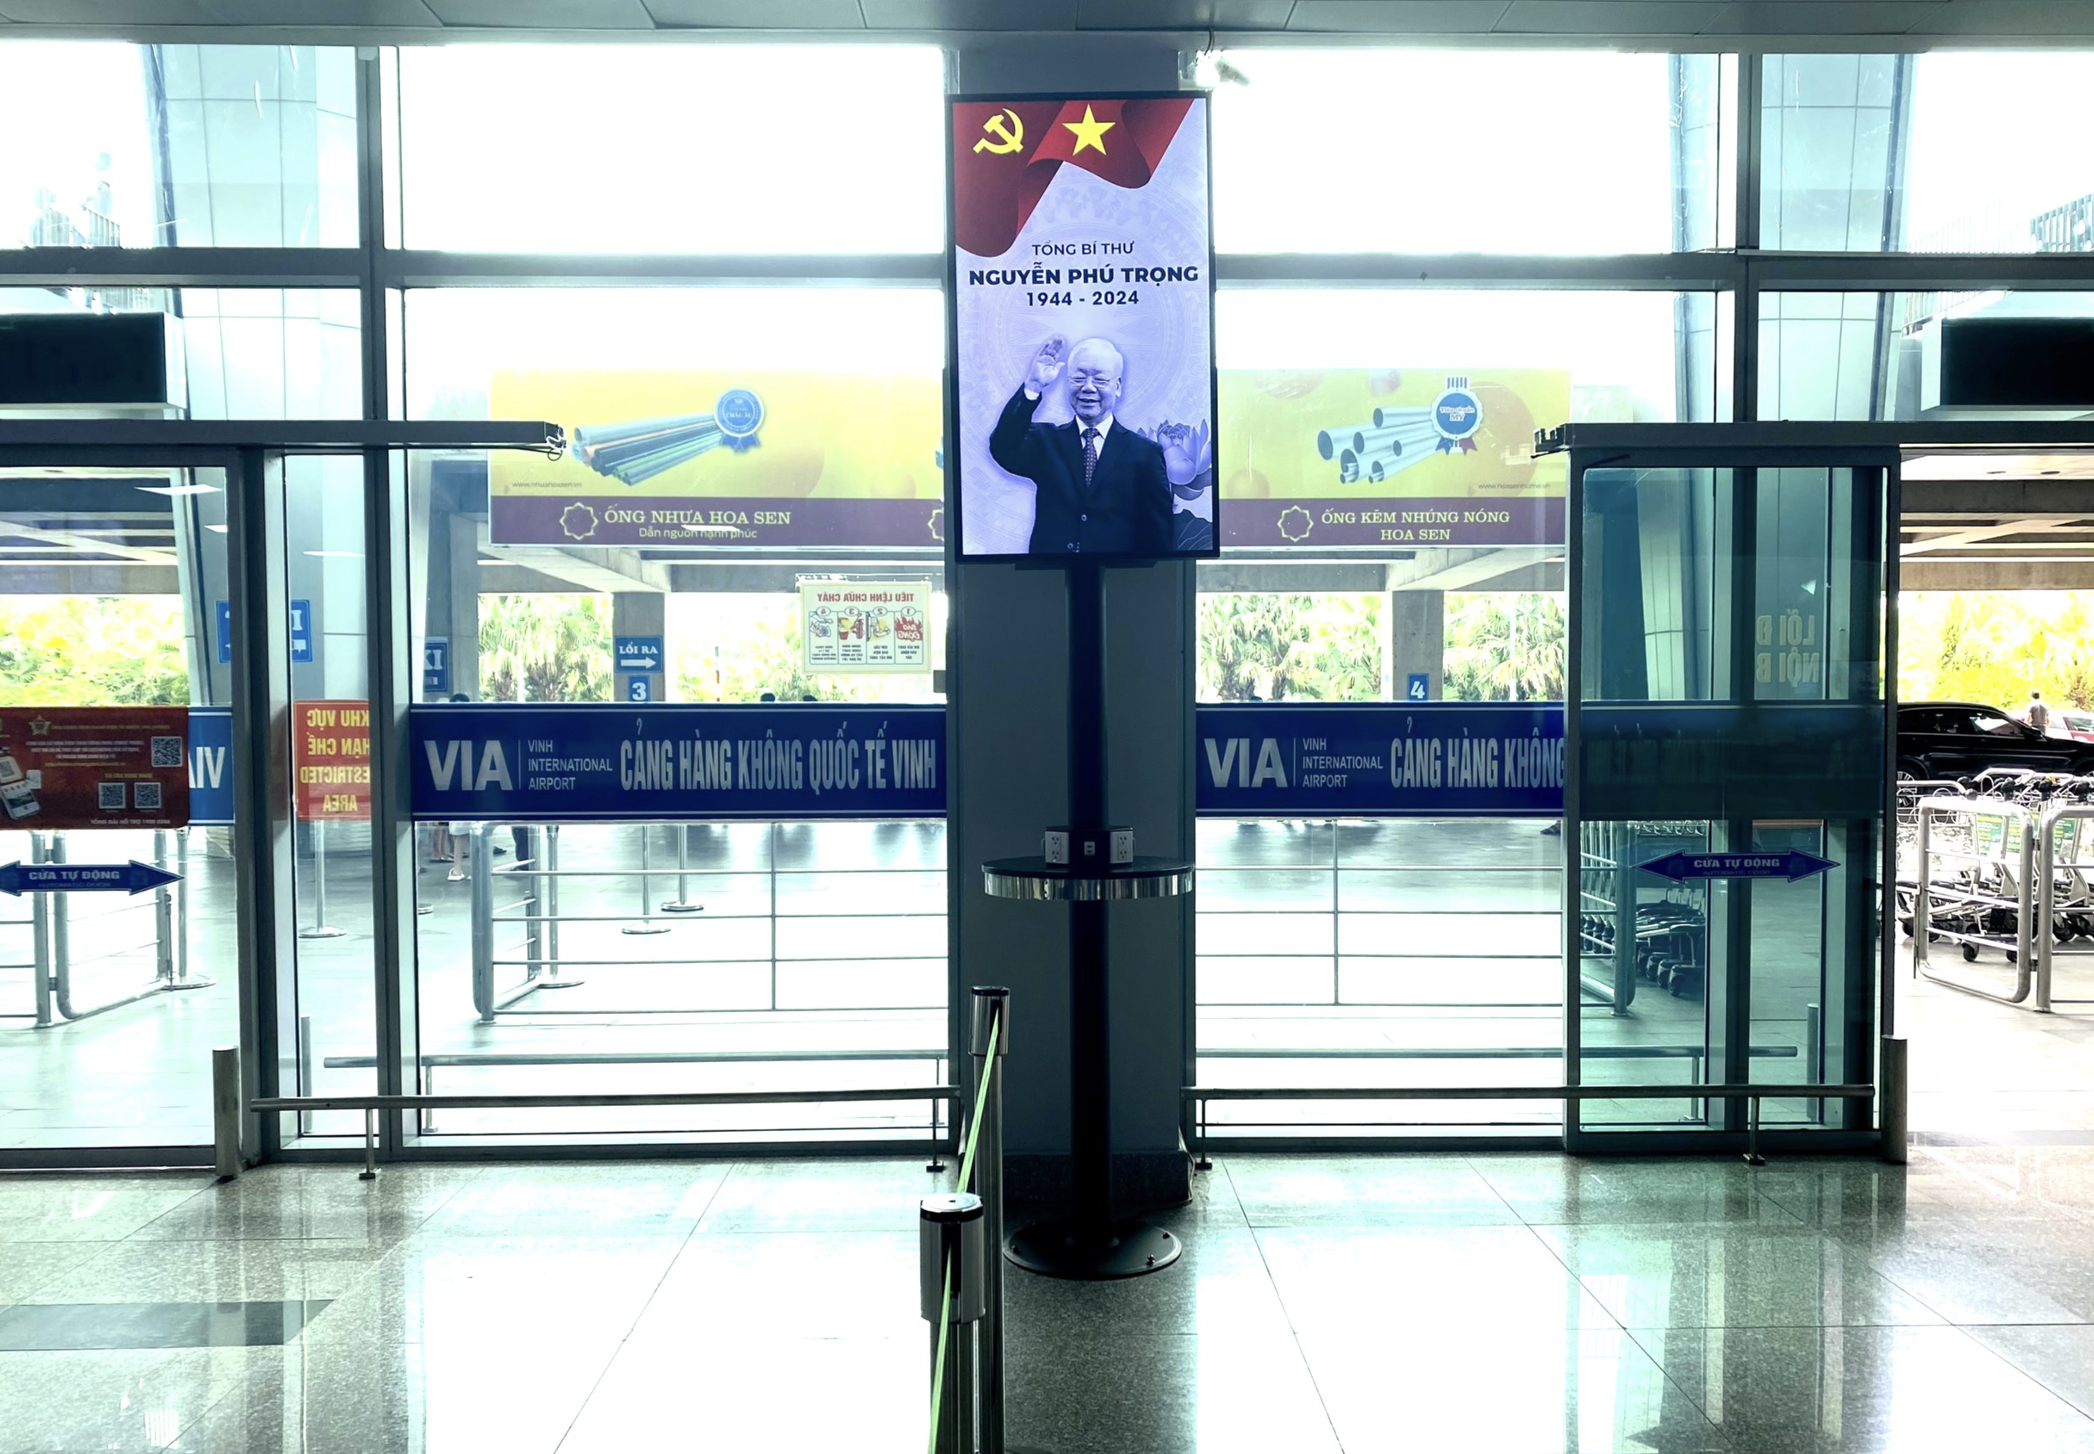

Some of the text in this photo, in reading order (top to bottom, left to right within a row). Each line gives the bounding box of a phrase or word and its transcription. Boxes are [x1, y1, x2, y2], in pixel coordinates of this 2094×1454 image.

[1032, 240, 1135, 255] TỔNG BÍ THƯ
[969, 261, 1199, 287] NGUYỄN PHÚ TRỌNG
[1026, 292, 1073, 306] 1944
[1092, 290, 1139, 306] 2024
[604, 503, 646, 523] ỐNG
[709, 511, 749, 524] HOA
[753, 511, 791, 525] SEN
[1321, 508, 1510, 524] ỐNG KẼM NHÚNG NÓNG
[639, 525, 661, 537] Dẫn
[1380, 529, 1451, 541] HOA SEN
[618, 641, 659, 654] LỐI RA
[632, 681, 647, 701] 3
[1410, 680, 1426, 699] 4
[528, 739, 553, 753] VINH
[1302, 738, 1327, 751] VINH
[620, 718, 936, 796] CẢNG HÀNG KHÔNG QUỐC TẾ VINH
[1390, 716, 1441, 788] CẢNG
[1447, 727, 1498, 788] HÀNG
[1504, 727, 1565, 788] KHÔNG
[423, 739, 513, 791] VIA
[528, 758, 613, 771] INTERNATIONAL
[1203, 737, 1288, 788] VIA
[1302, 756, 1384, 769] INTERNATIONAL
[528, 777, 576, 790] AIRPORT
[1302, 774, 1348, 788] AIRPORT
[1724, 858, 1742, 869] TỰ
[60, 870, 79, 881] TỰ
[81, 869, 120, 881] ĐỘNG
